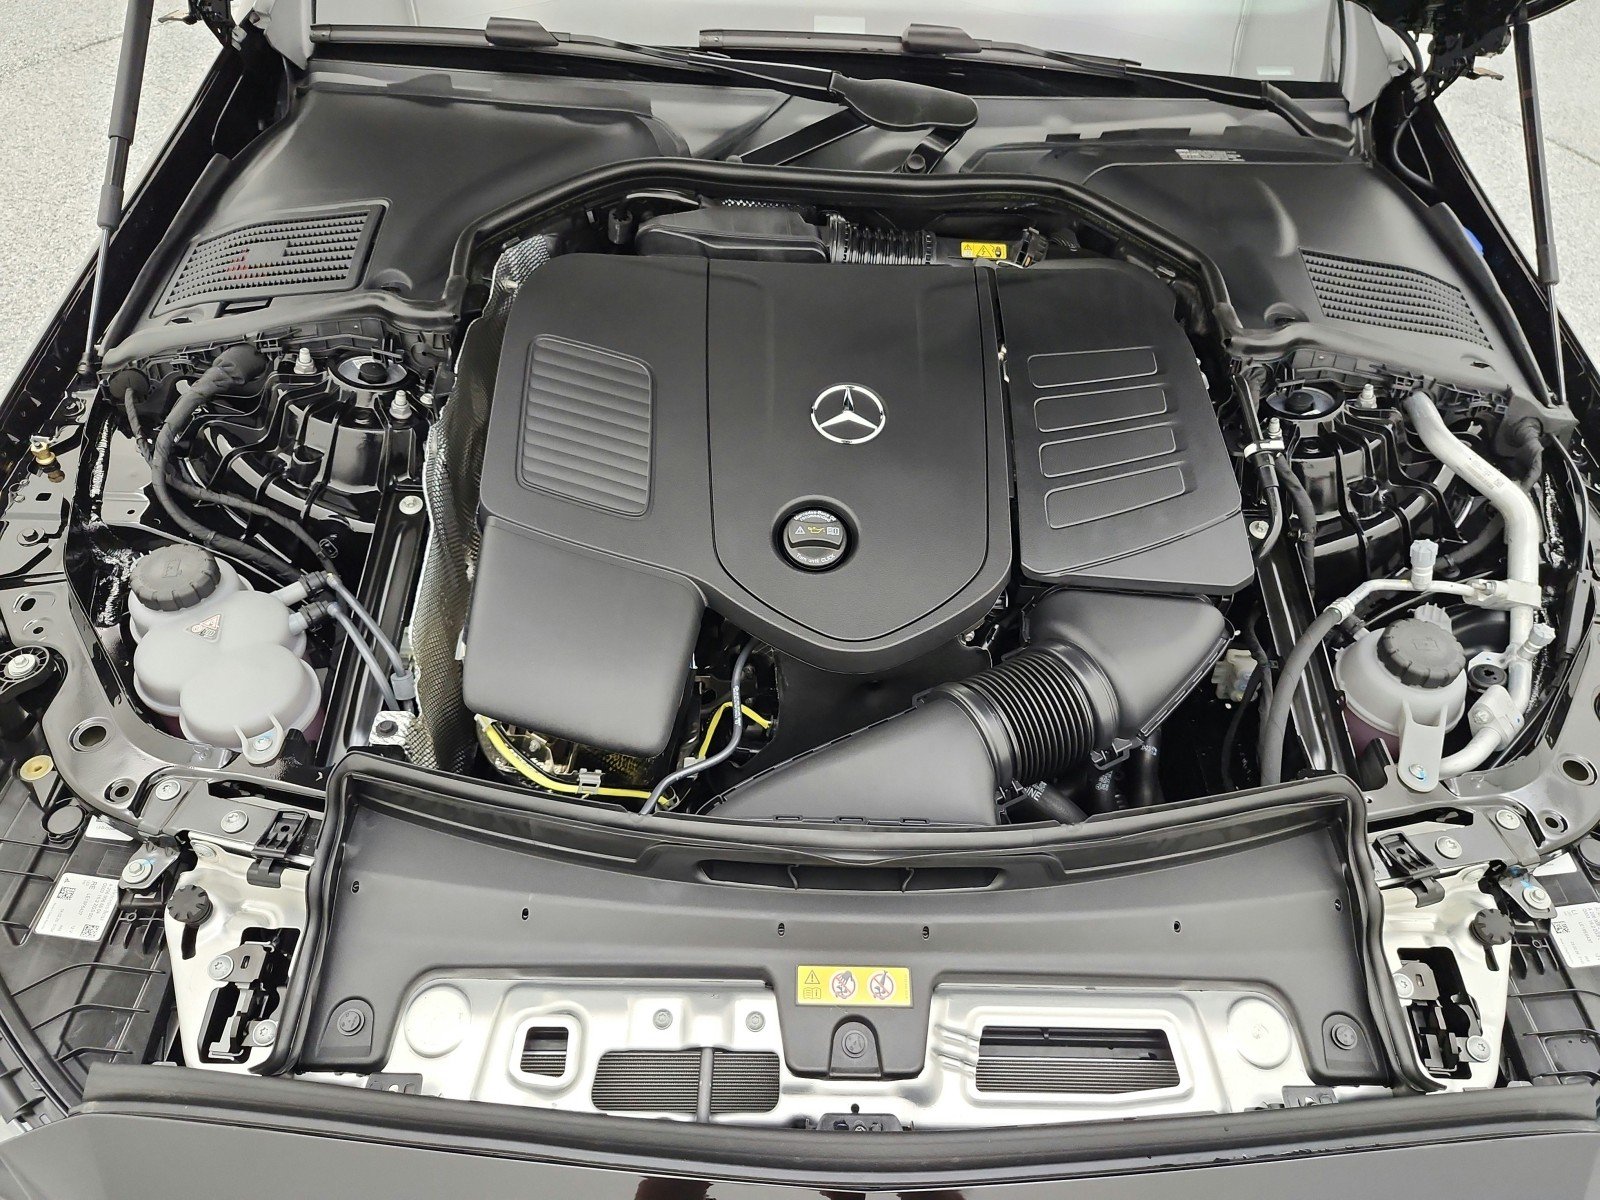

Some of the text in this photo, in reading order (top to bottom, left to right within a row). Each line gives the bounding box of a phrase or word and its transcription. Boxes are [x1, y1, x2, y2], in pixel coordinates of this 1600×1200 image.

[794, 510, 830, 520] Mercedes-Benz
[800, 514, 831, 522] recommended
[796, 552, 806, 561] Turn
[821, 553, 835, 562] CLICK
